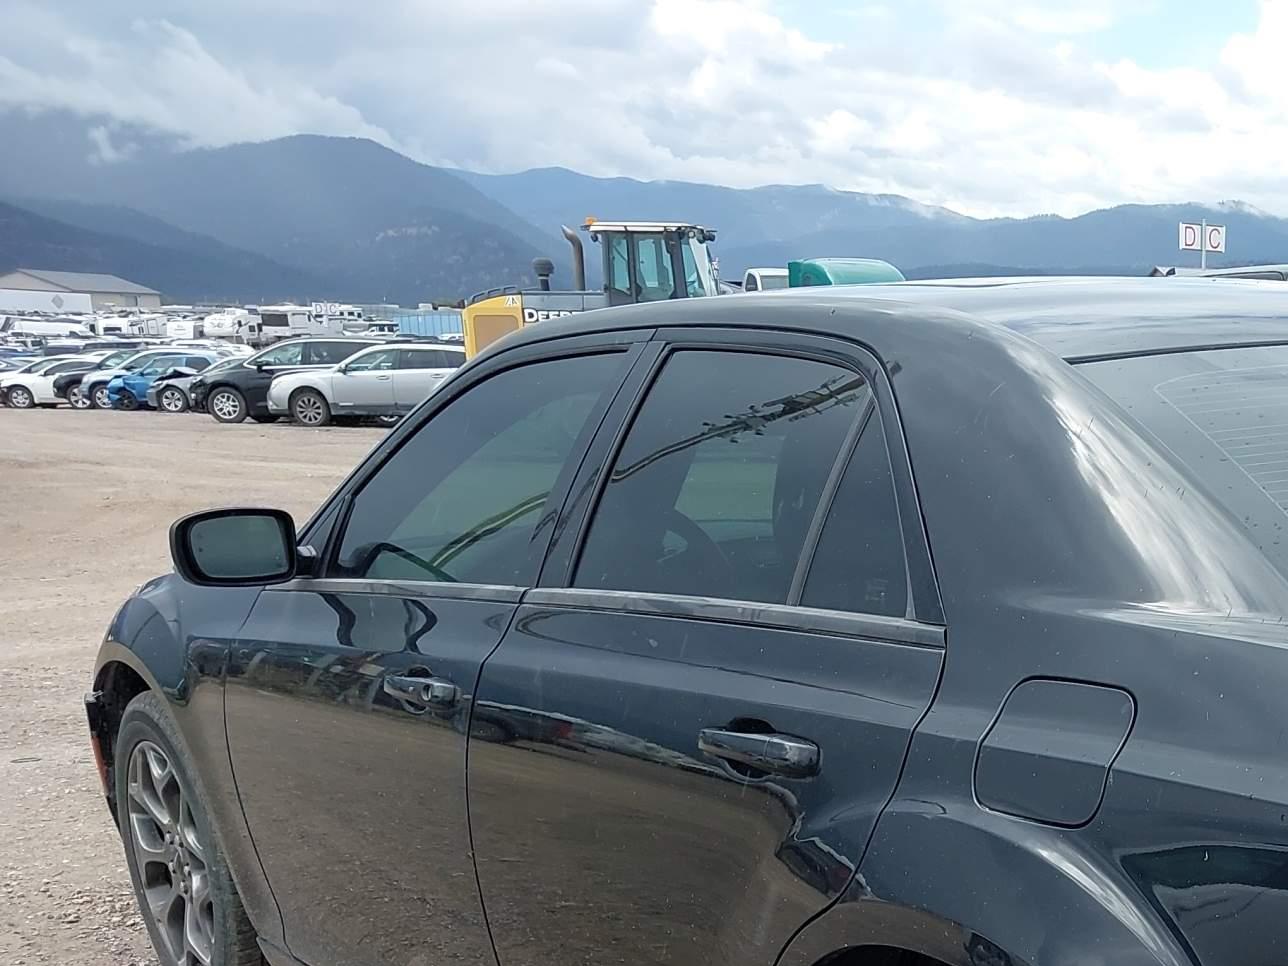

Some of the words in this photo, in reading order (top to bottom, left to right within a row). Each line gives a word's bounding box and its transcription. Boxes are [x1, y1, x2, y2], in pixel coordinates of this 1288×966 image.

[1184, 226, 1196, 247] D
[1208, 228, 1221, 249] C
[523, 308, 585, 323] DEER
